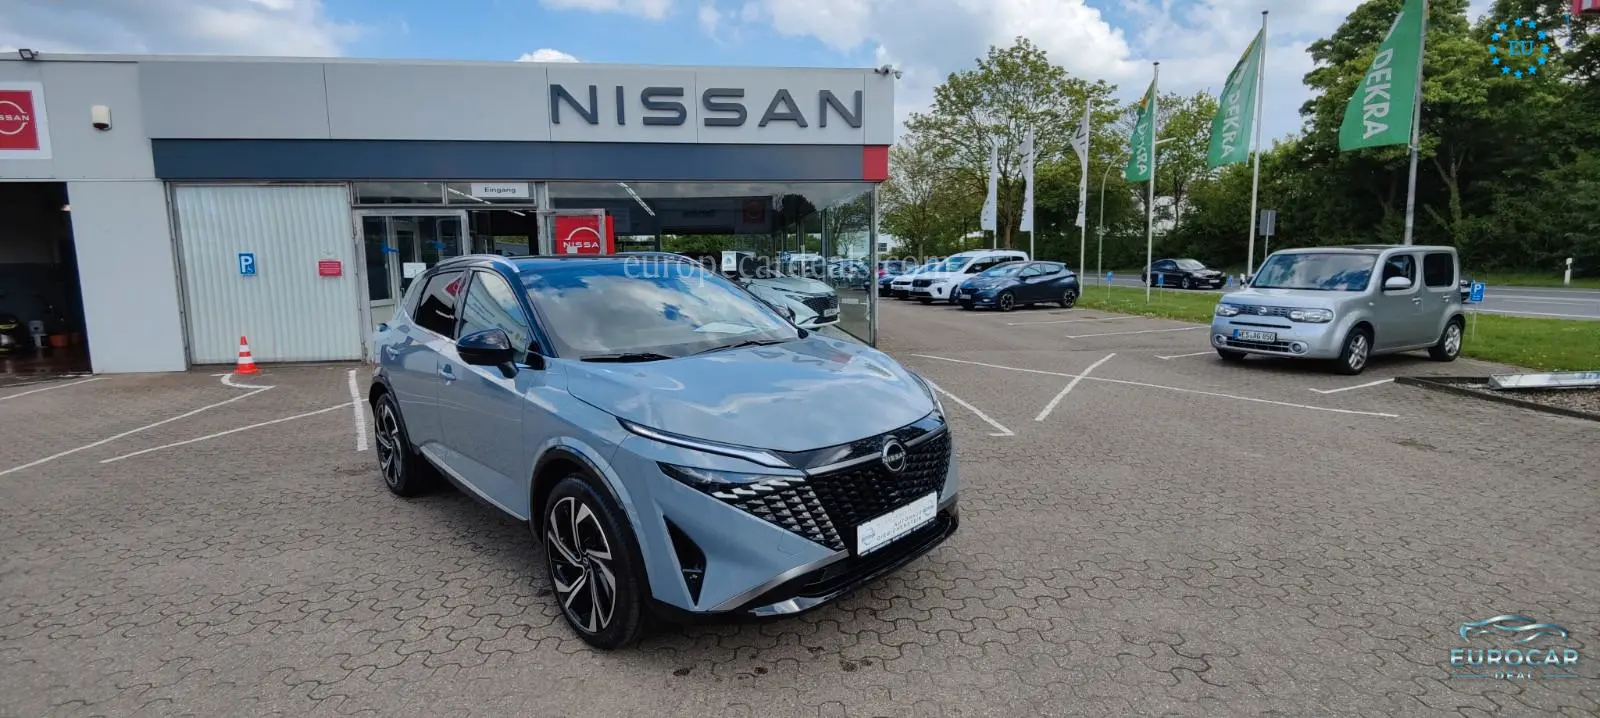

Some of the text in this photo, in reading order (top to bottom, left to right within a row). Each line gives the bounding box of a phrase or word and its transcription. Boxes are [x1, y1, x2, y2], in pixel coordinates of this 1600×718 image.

[1362, 47, 1394, 140] DEKRA
[549, 84, 863, 128] NISSAN
[1219, 89, 1241, 159] DEKRA
[484, 186, 517, 194] Eingang
[563, 241, 600, 249] NISSA
[240, 255, 253, 273] P
[1473, 284, 1482, 294] P
